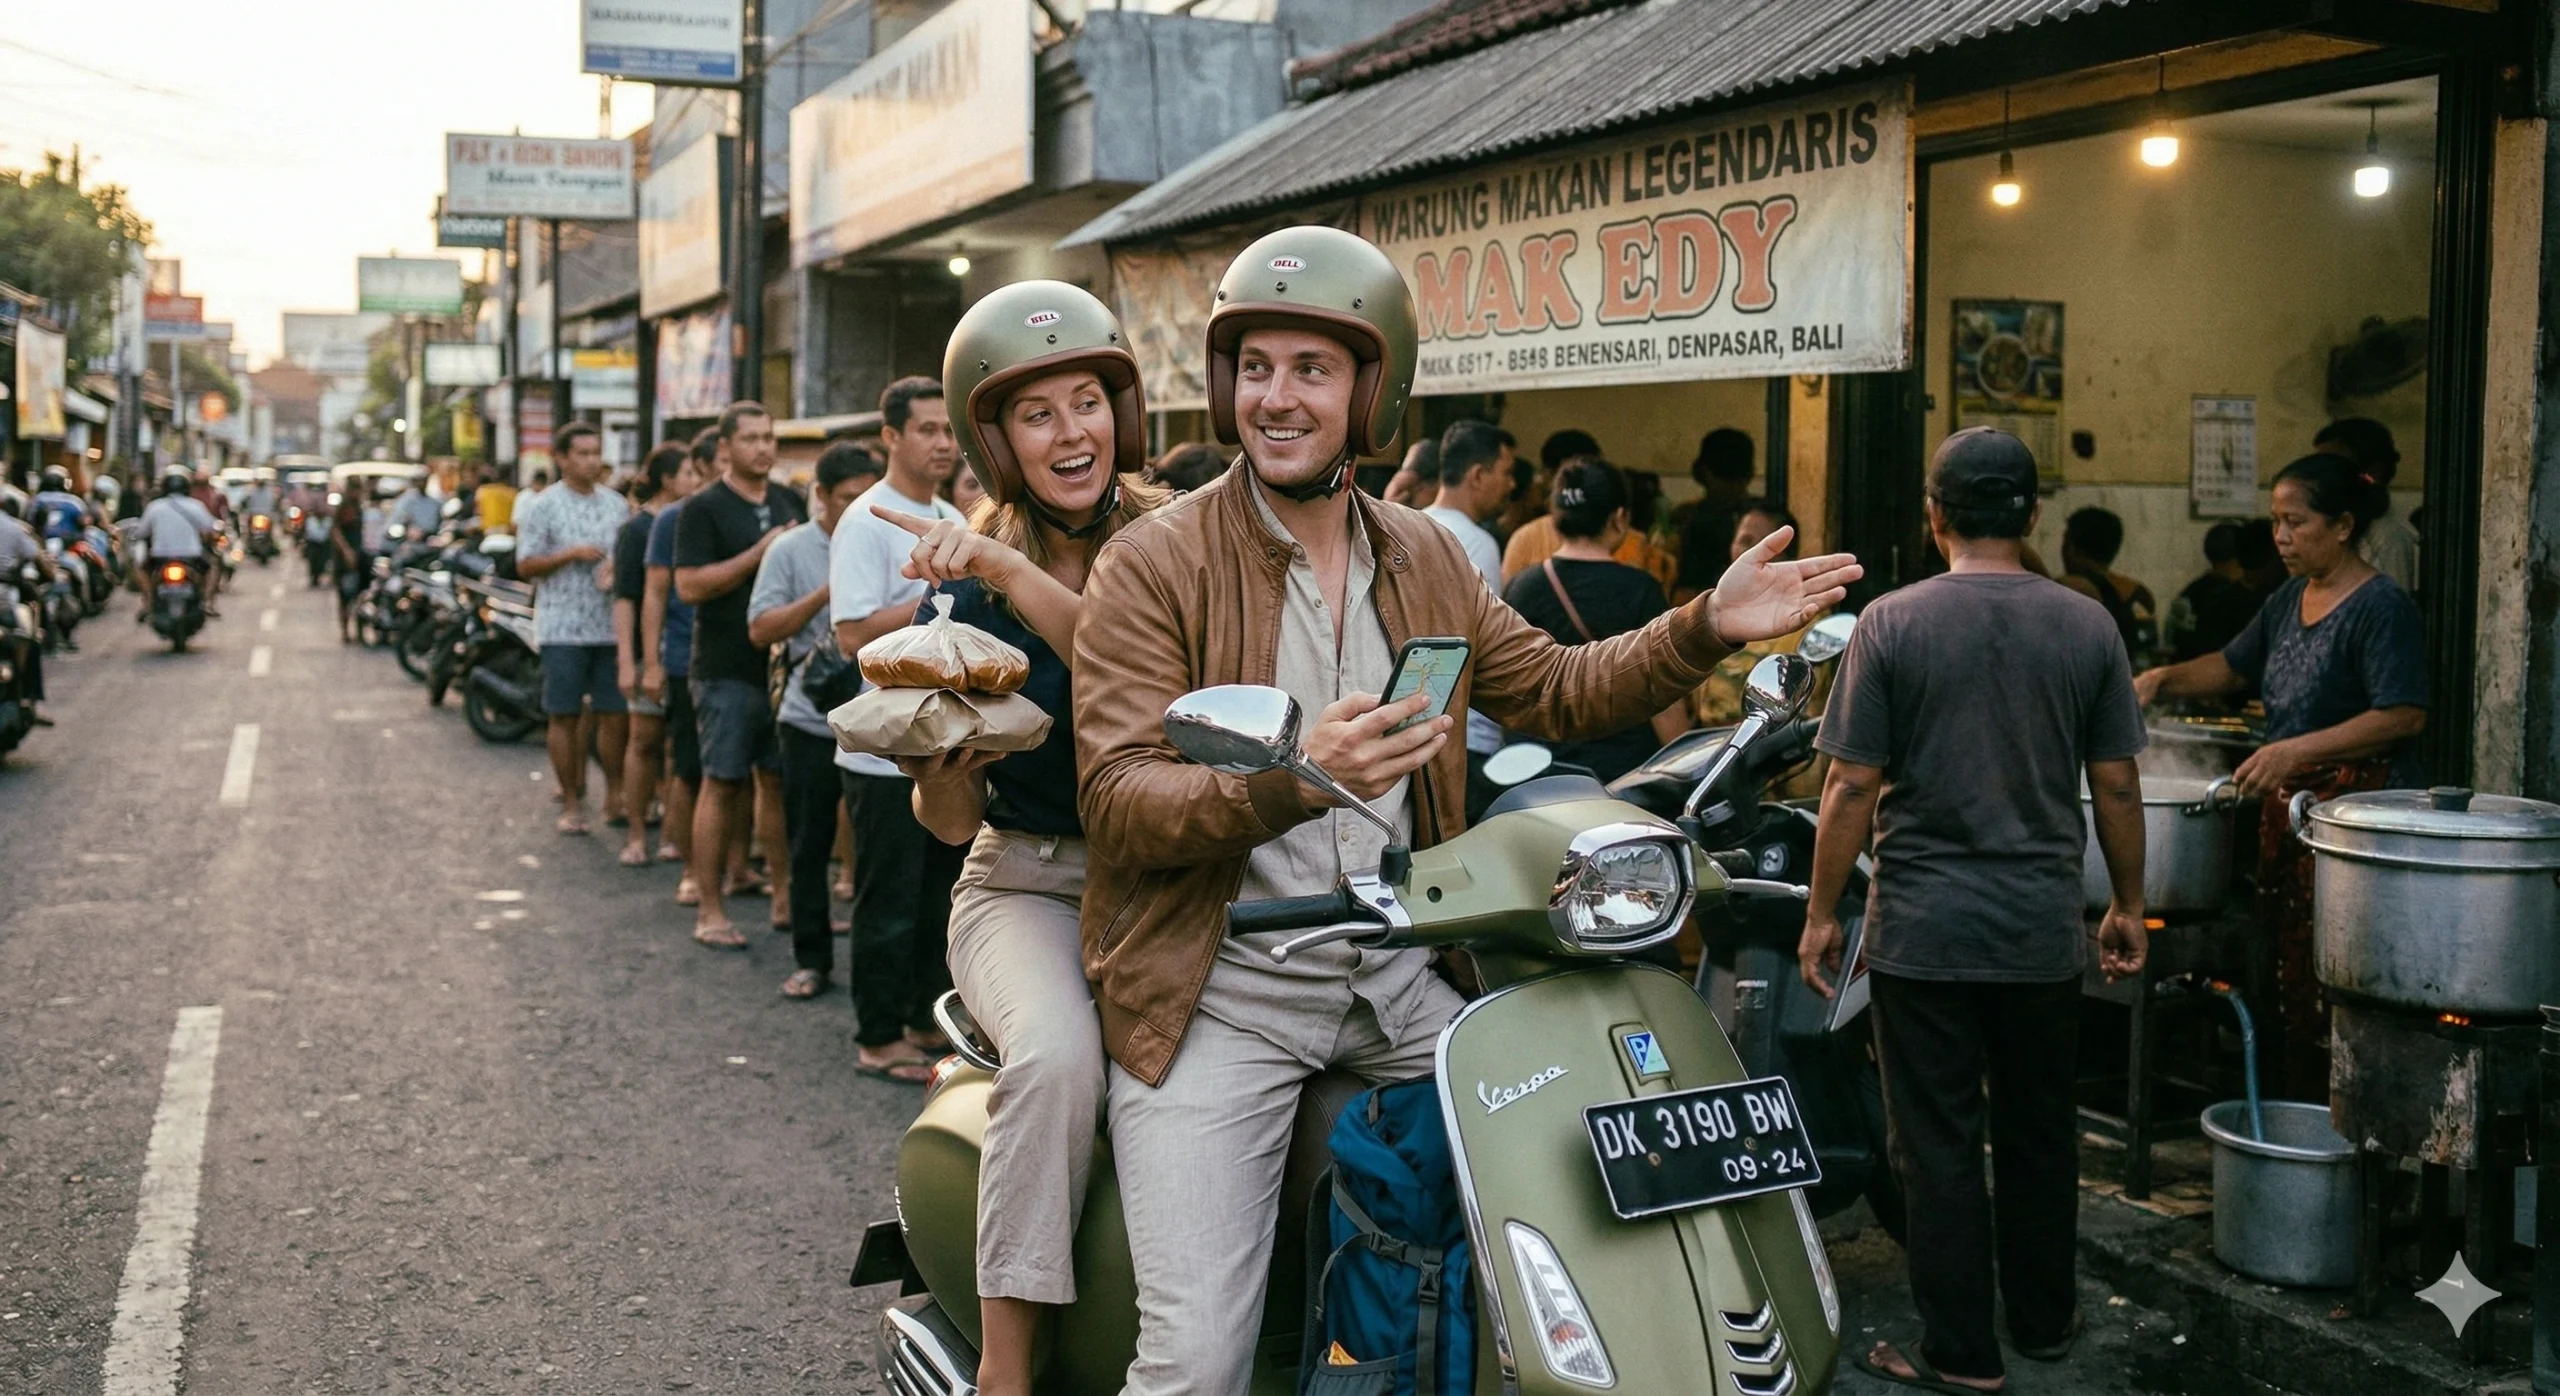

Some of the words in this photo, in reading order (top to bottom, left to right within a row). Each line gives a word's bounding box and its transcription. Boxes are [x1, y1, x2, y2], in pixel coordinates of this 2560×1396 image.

[1374, 181, 1490, 245] WARUNG
[1500, 155, 1612, 225] MAKAN
[1623, 101, 1878, 203] LEGENDARIS
[1415, 229, 1582, 343] MAK
[1596, 194, 1797, 326] EDY
[1555, 338, 1662, 367] BENENSARI,
[1668, 328, 1784, 360] DENPASAR,
[1792, 323, 1843, 352] BALI
[1477, 1065, 1570, 1115] Vespa
[1596, 1111, 1647, 1160] DK
[1655, 1099, 1737, 1150] 3190
[1743, 1088, 1793, 1135] BW
